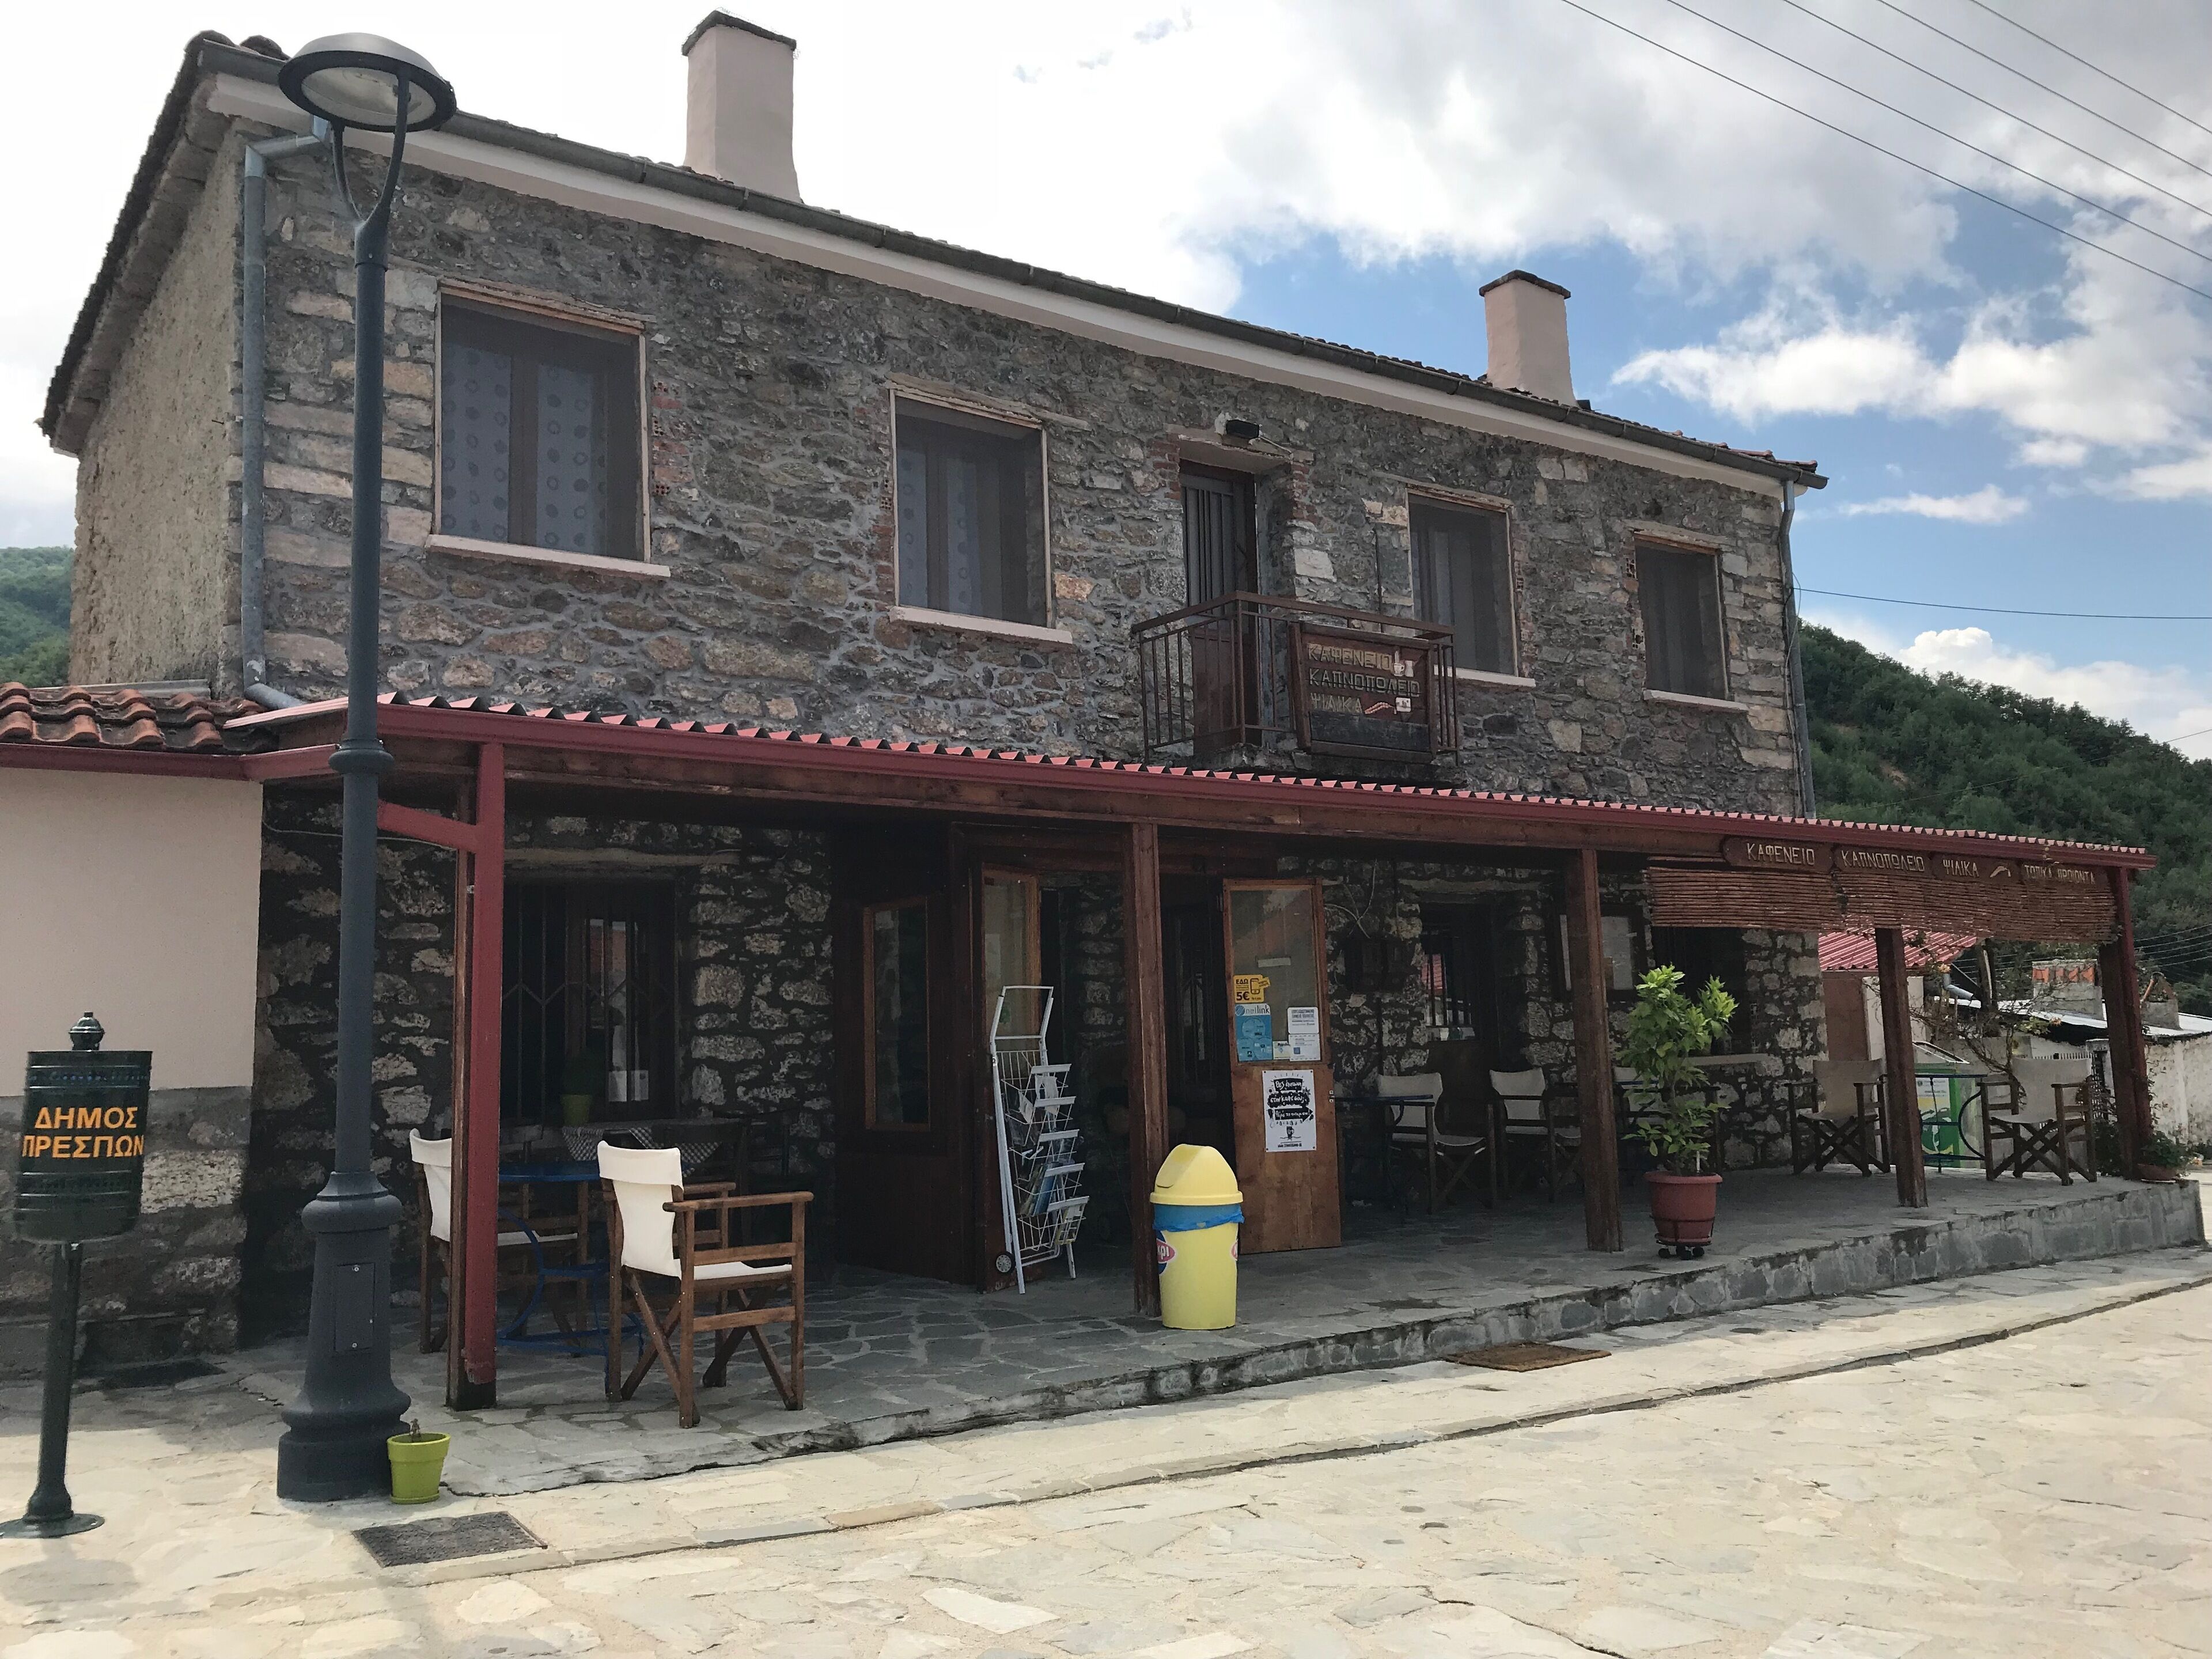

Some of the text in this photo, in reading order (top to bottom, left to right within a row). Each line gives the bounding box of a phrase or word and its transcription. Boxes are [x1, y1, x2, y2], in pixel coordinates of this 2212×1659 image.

[1747, 842, 1815, 866] ΚΑΦΕΝΕΙΟ
[1942, 859, 1980, 878] ΨΙΛΙΚΑ
[1236, 991, 1250, 1001] 5€
[1245, 1005, 1270, 1014] netlink
[34, 1106, 138, 1130] ΔΗΜΟΣ
[22, 1134, 144, 1158] ΠΡΕΣΠΩΝ
